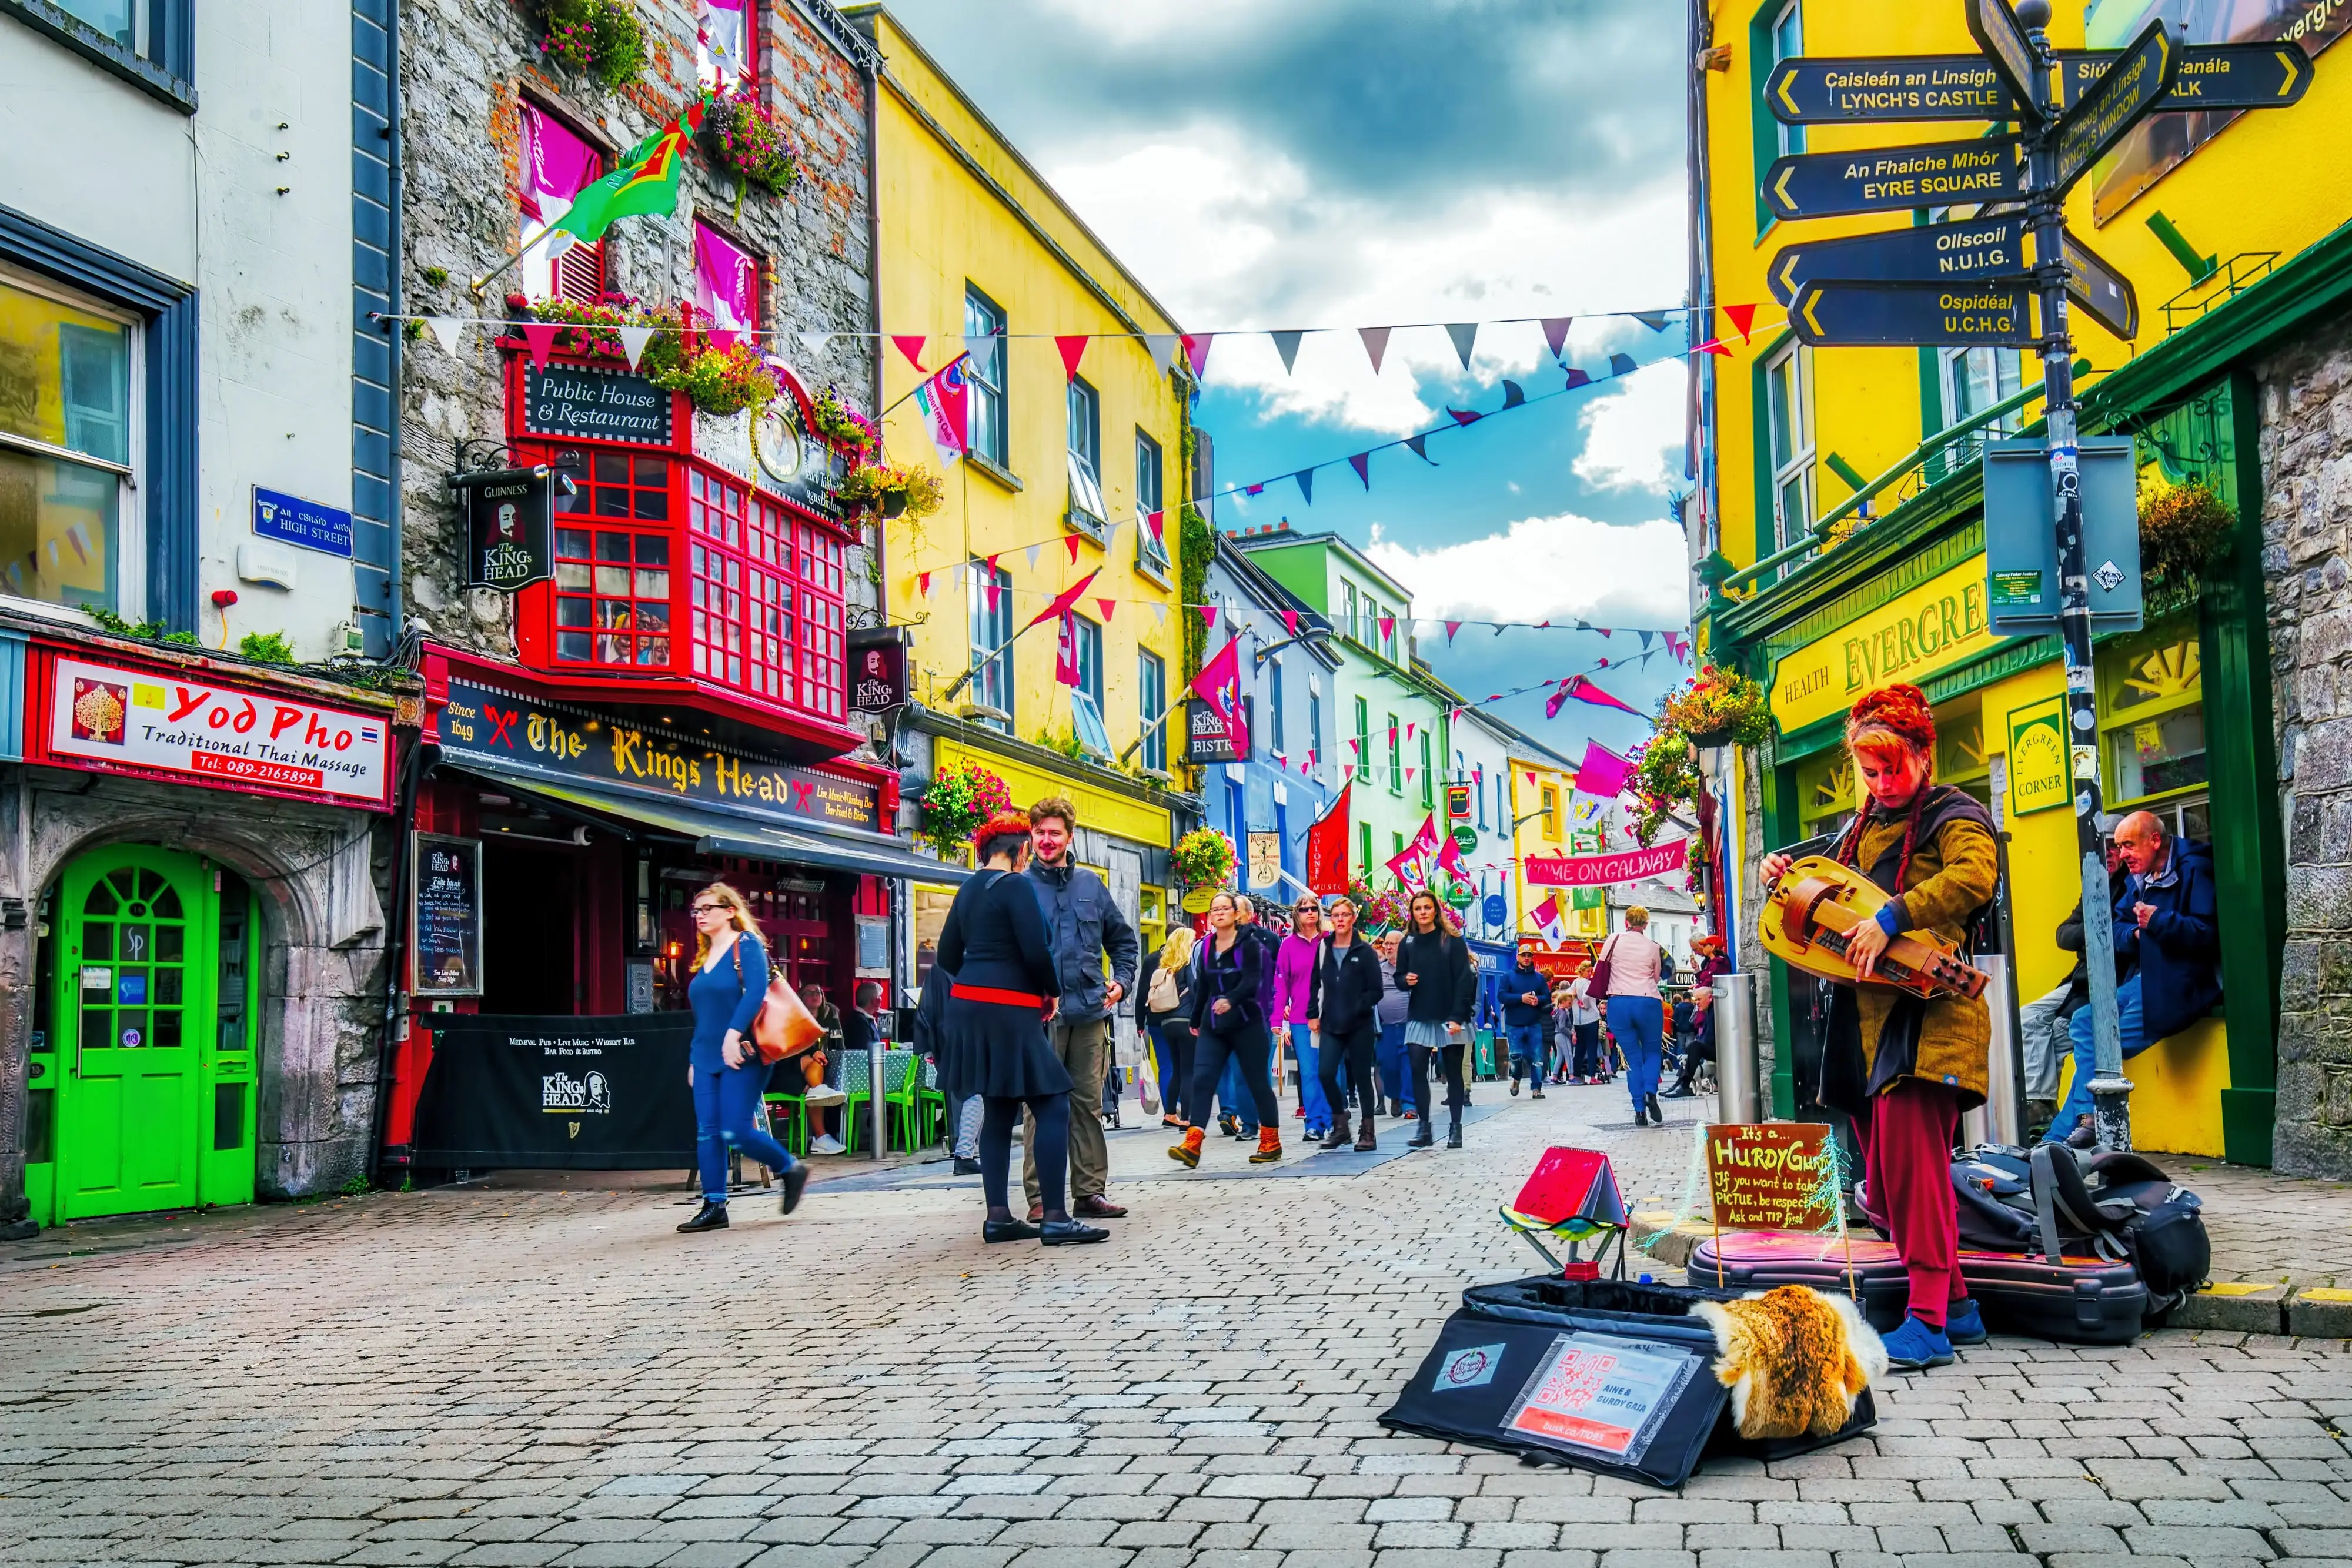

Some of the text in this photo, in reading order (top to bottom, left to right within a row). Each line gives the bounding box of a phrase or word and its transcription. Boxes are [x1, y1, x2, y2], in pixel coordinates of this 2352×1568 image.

[1825, 69, 1997, 88] Caisleán an Linsigh
[1925, 89, 1999, 107] CASTLE
[2059, 54, 2147, 153] Fuinneog an Linsigh
[2098, 83, 2140, 137] WINDOW
[1843, 151, 1999, 179] An Fhaiche Mhór
[1864, 172, 2002, 199] EYRE SQUARE
[1936, 226, 2007, 250] Ollscoil
[1940, 249, 2010, 273] N.U.I.G.
[1939, 293, 2013, 313] Ospidéal
[1945, 316, 2016, 332] U.C.H.G.
[541, 377, 656, 408] Public House
[538, 402, 660, 430] & Restaurant
[925, 382, 953, 442] Supporters Club
[484, 484, 528, 498] GUINNESS
[280, 518, 349, 547] HIGH STREET
[499, 542, 513, 553] The
[483, 563, 529, 581] HEAD
[1842, 577, 1990, 696] EVERGRE
[1784, 666, 1829, 704] HEALTH
[447, 701, 476, 718] Since
[856, 694, 890, 707] HEAD
[167, 686, 353, 752] Yod Pho
[1192, 724, 1223, 735] HEAD
[451, 718, 473, 743] 1649
[141, 724, 366, 779] Traditional Thai Massage
[1192, 739, 1234, 754] BISTR
[2016, 733, 2062, 775] EVERGREEN
[527, 712, 789, 805] The Kings Head
[199, 755, 316, 785] Tel: 089-2165894
[2019, 774, 2062, 797] CORNER
[816, 785, 828, 800] Live
[864, 796, 874, 809] Bar
[825, 802, 868, 822] Bar Food & Bistro
[1250, 833, 1279, 847] MOLONEY
[432, 863, 449, 872] HEAD
[1578, 862, 1603, 881] ON
[1604, 850, 1675, 878] GALWAY
[1312, 883, 1342, 891] MUSIC
[555, 1072, 568, 1082] The
[542, 1093, 582, 1106] HEAD
[1714, 1171, 1819, 1193] If you want to take
[1759, 1192, 1770, 1206] be
[1728, 1209, 1805, 1229] Ask and TIP first
[1624, 1388, 1632, 1396] &
[1597, 1395, 1647, 1413] GURDY GAIA
